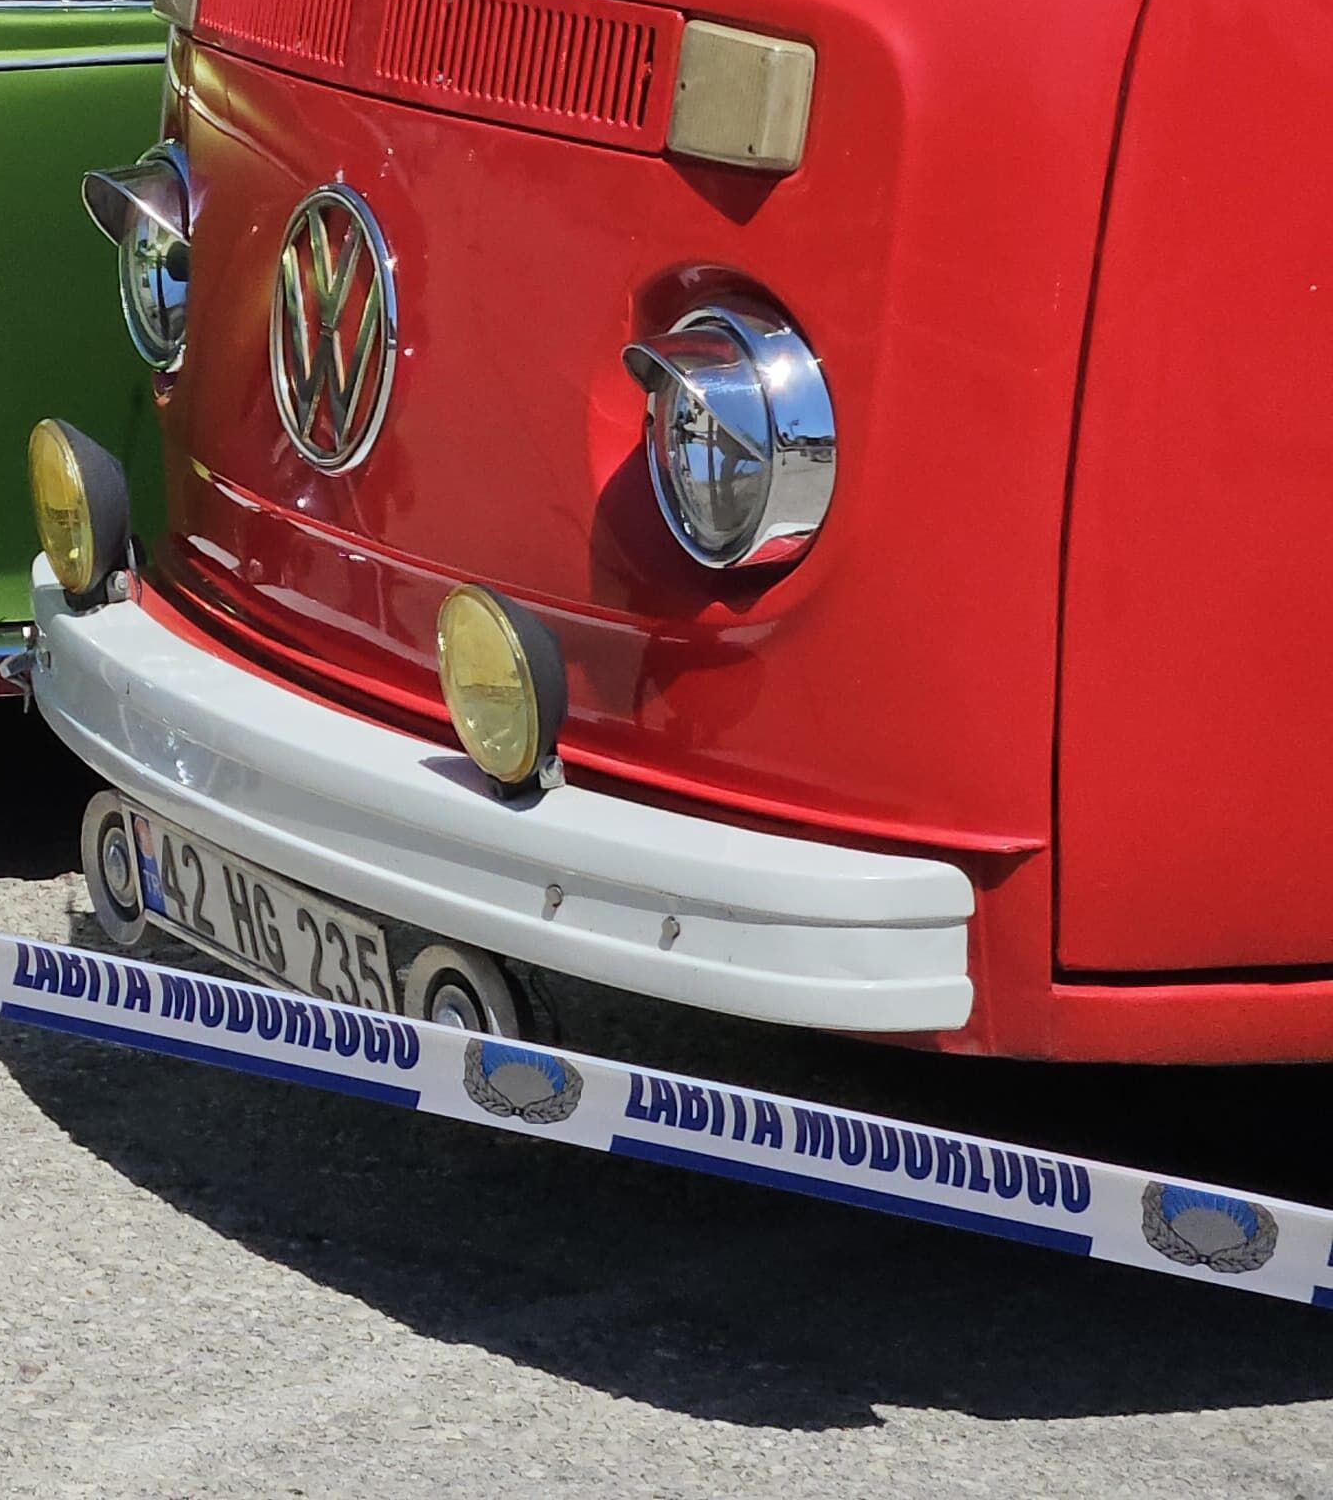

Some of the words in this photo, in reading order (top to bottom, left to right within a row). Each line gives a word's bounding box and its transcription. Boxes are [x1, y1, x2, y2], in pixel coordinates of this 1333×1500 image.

[142, 868, 162, 901] TR
[161, 834, 215, 937] 42
[223, 864, 286, 975] HG
[296, 906, 391, 1012] 235
